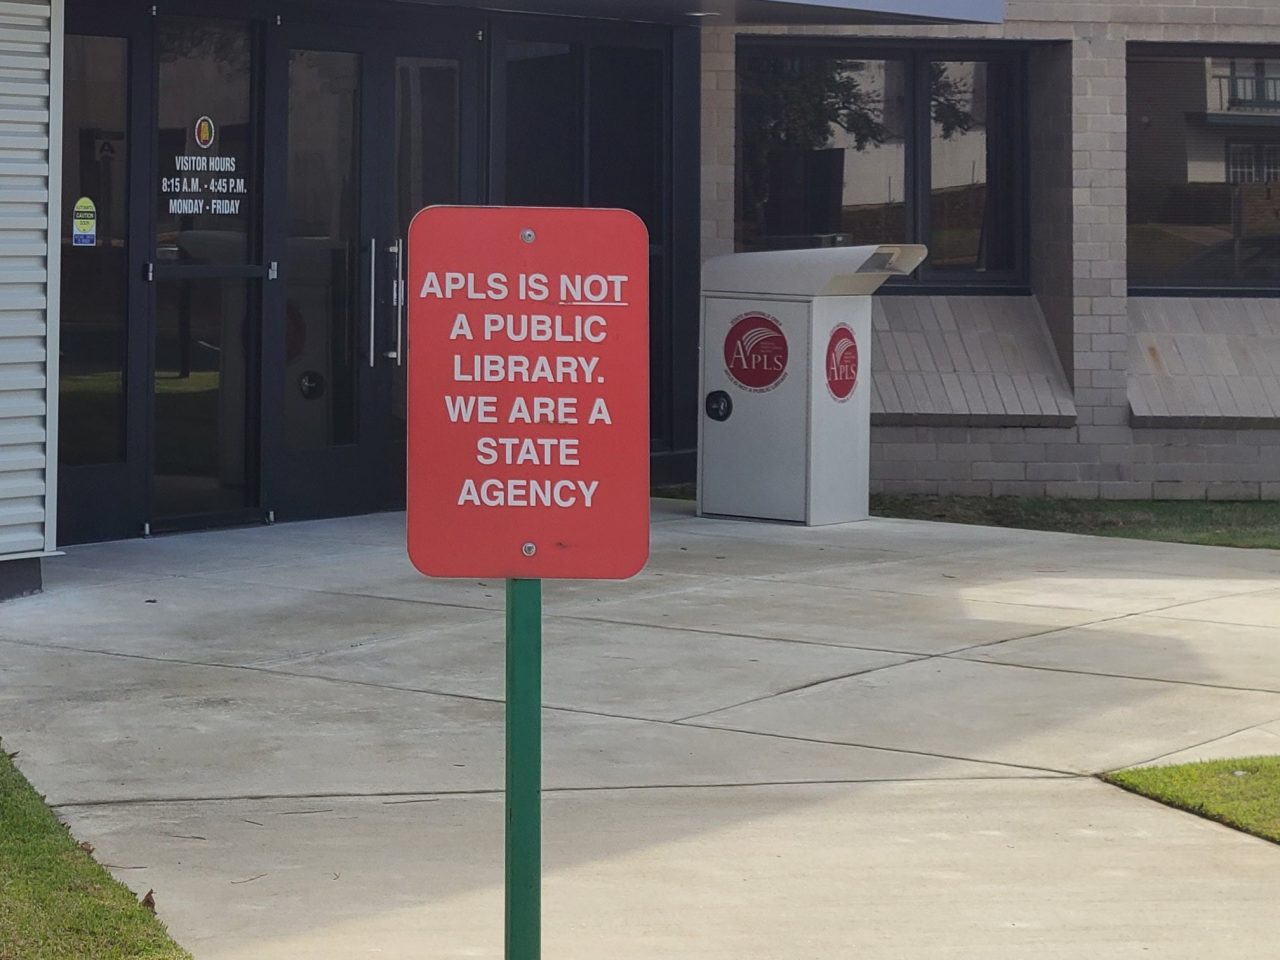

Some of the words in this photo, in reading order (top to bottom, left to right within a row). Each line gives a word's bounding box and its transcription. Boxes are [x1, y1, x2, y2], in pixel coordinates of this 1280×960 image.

[175, 156, 207, 171] VISITOR
[209, 157, 236, 172] HOURS
[162, 177, 180, 192] 8:15
[182, 177, 202, 192] A.M.
[209, 178, 227, 193] 4:45
[229, 178, 247, 193] P.M.
[169, 199, 204, 214] MONDAY
[211, 199, 240, 214] FRIDAY
[420, 272, 508, 300] APLS
[519, 274, 549, 300] IS
[560, 275, 629, 304] NOT
[449, 314, 473, 340] A
[485, 314, 608, 342] PUBLIC
[453, 355, 605, 383] LIBRARY.
[729, 340, 784, 371] APLS
[828, 352, 857, 381] APLS
[445, 396, 498, 423] WE
[508, 397, 578, 424] ARE
[588, 399, 612, 425] A
[476, 437, 580, 466] STATE
[457, 479, 599, 507] AGENCY
